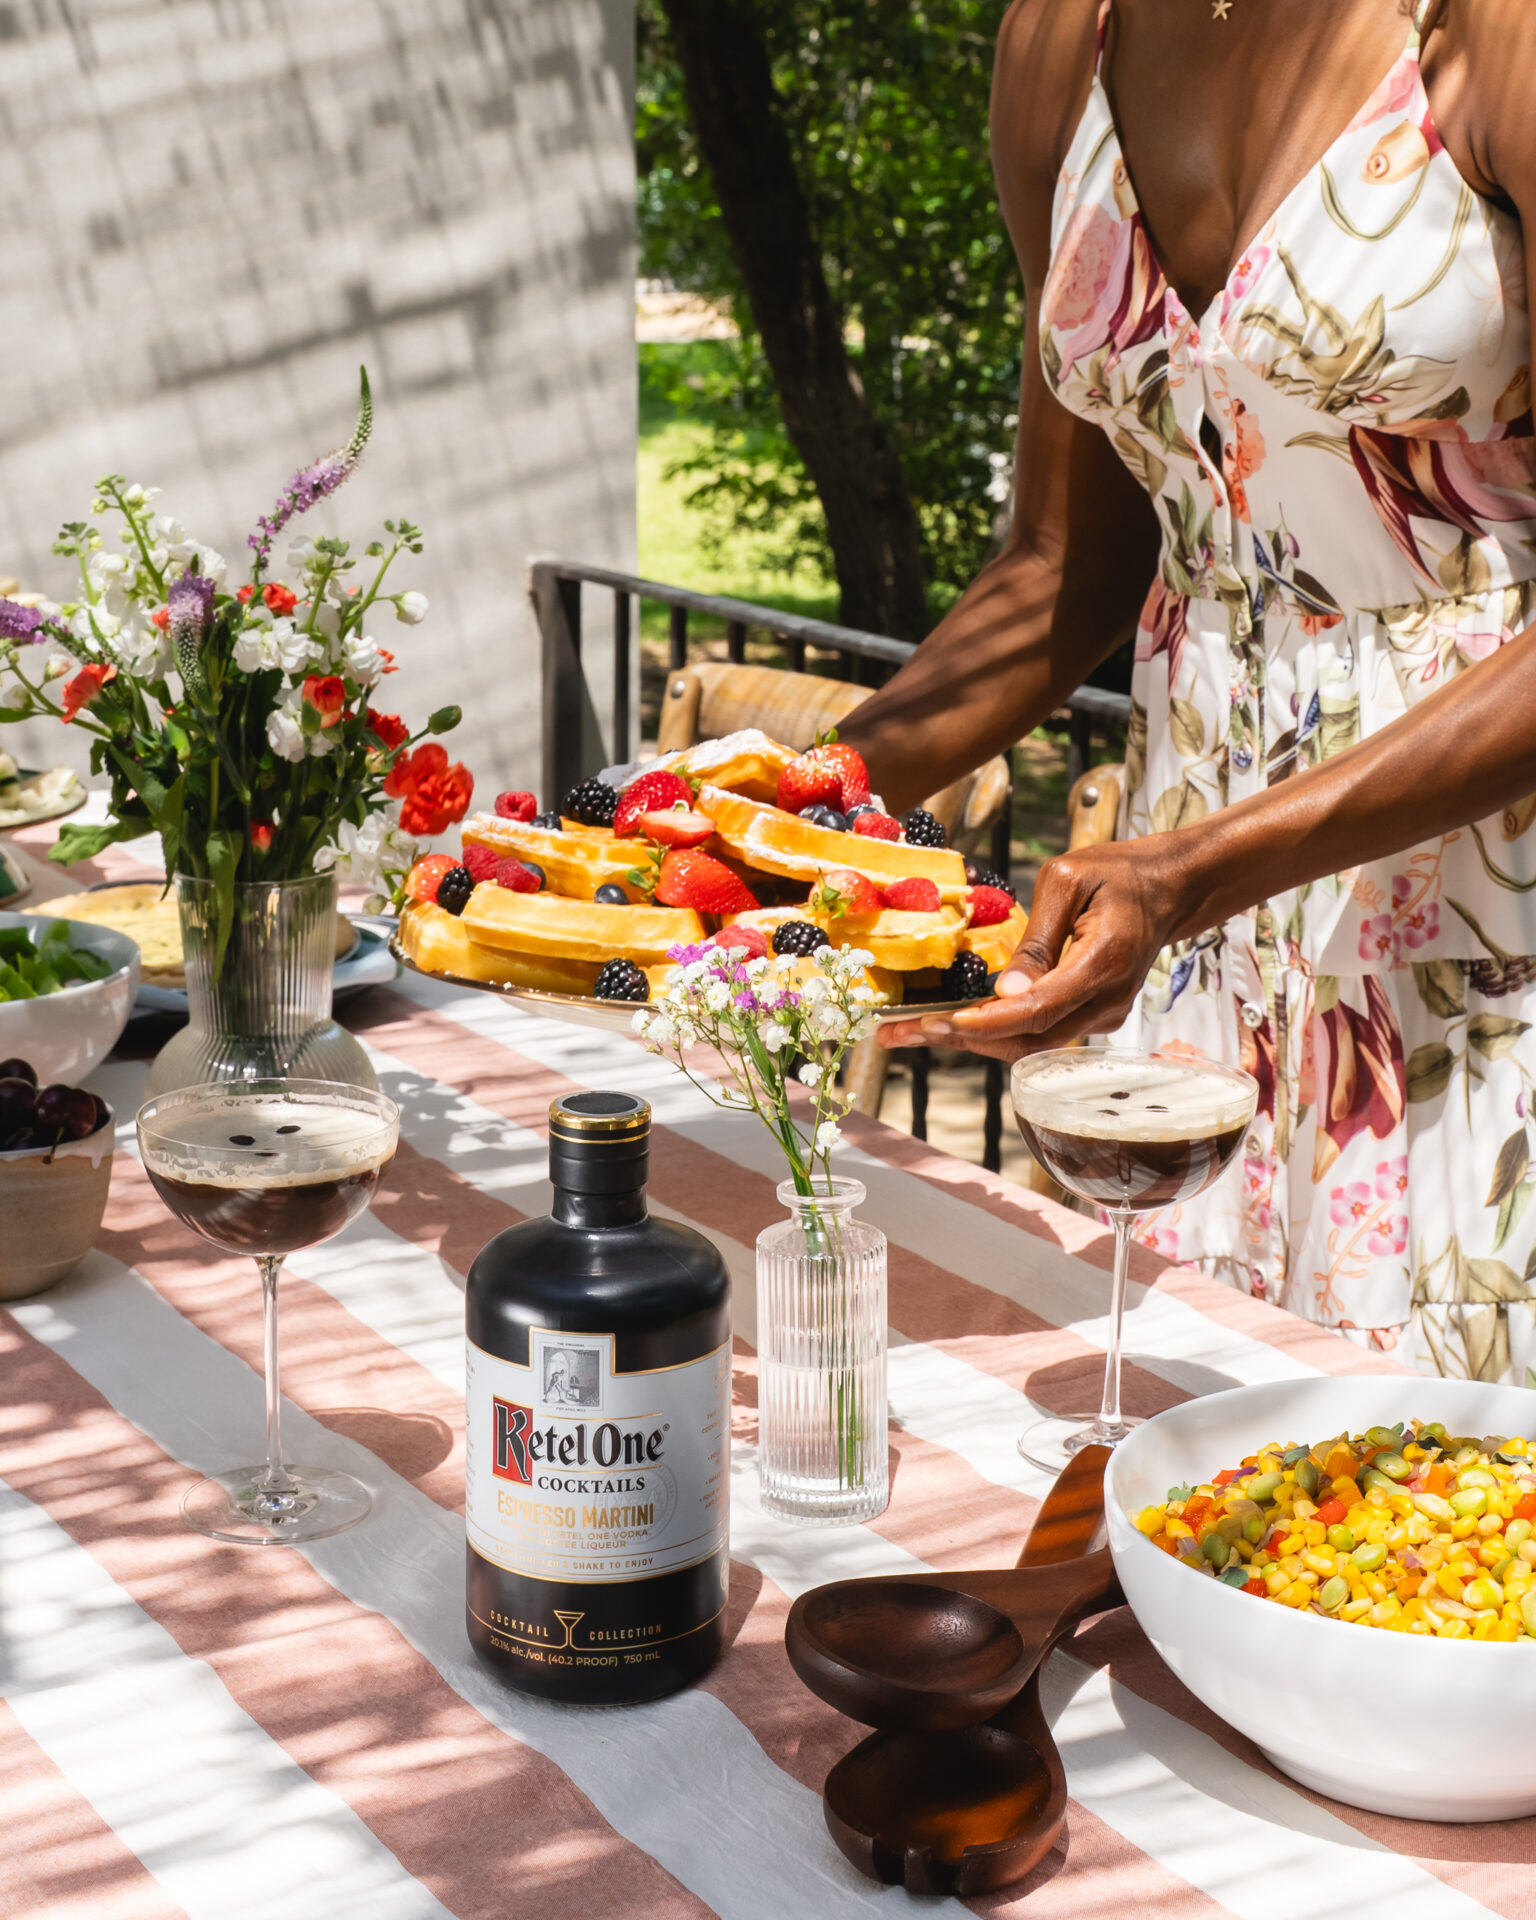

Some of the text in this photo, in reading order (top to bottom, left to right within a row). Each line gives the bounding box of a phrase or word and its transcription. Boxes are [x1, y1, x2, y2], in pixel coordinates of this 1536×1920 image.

[494, 1402, 590, 1480] Ketel
[537, 1476, 646, 1494] COCKTAILS
[497, 1489, 654, 1529] ESPRESSO MARTINI
[587, 1531, 610, 1541] ONE
[613, 1528, 649, 1540] VODKA
[581, 1540, 627, 1551] LIQUEUR
[573, 1560, 605, 1570] SHAKE
[609, 1560, 621, 1569] TO
[625, 1557, 654, 1569] ENJOY
[490, 1609, 662, 1641] COCKTAIL COLLECTION
[511, 1646, 546, 1662] alc./vol.
[548, 1653, 574, 1665] (40.2
[576, 1655, 618, 1668] PROOF)
[623, 1653, 643, 1665] 750
[645, 1649, 661, 1662] mL
